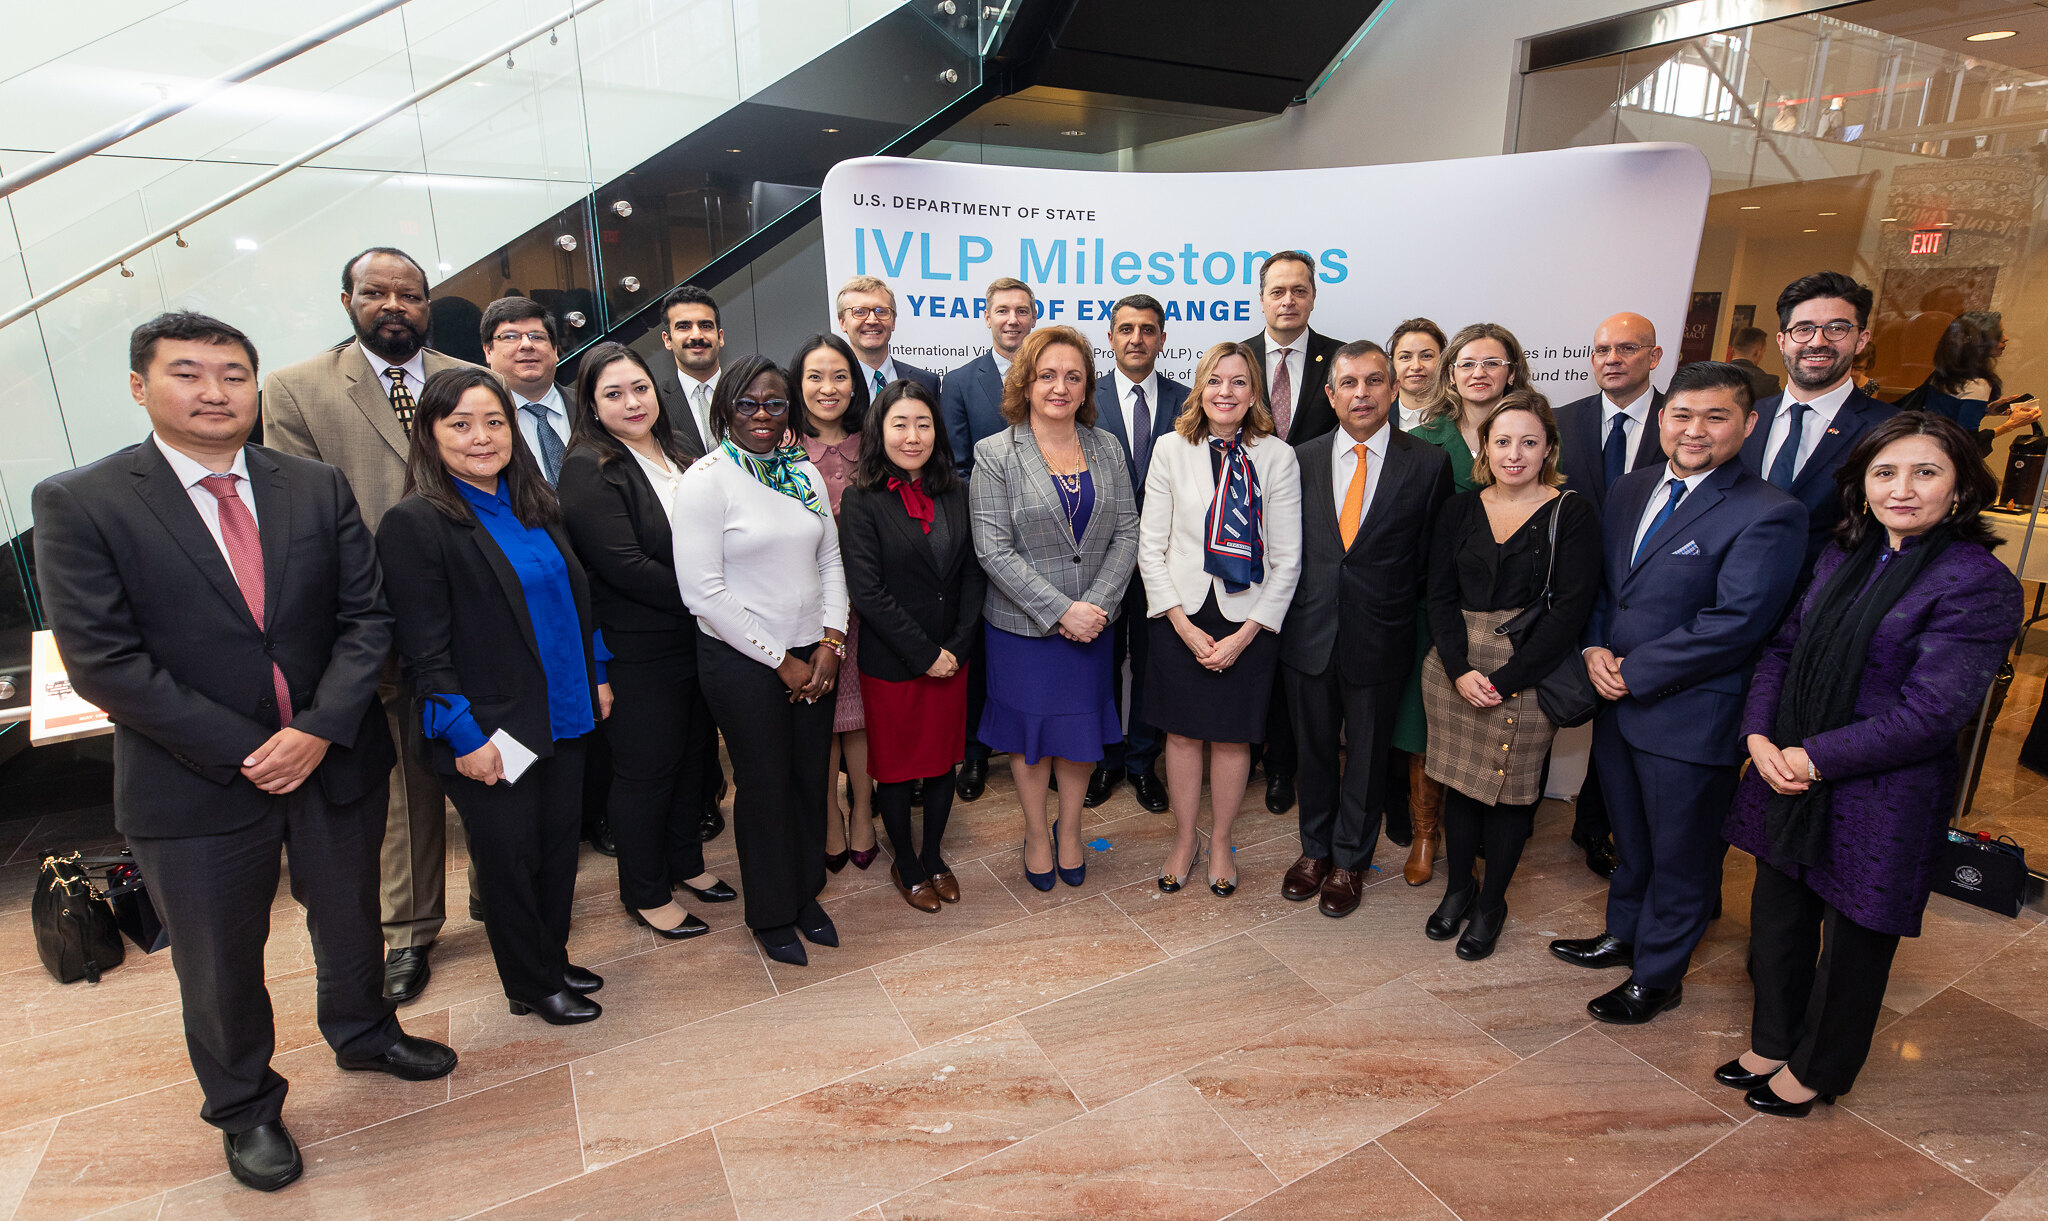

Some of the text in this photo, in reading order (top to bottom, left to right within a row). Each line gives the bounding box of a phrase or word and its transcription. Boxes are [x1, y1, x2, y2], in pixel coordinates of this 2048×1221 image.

[853, 193, 1096, 221] U.S. DEPARTMENT OF STATE
[1910, 233, 1942, 254] EXIT
[855, 228, 1349, 285] IVLP Milestons
[906, 295, 986, 318] YEAR
[1078, 299, 1251, 321] EXANGE
[888, 344, 968, 357] International
[1093, 347, 1114, 359] Pro
[1544, 346, 1557, 358] in
[1563, 346, 1593, 358] buil
[1178, 368, 1192, 379] of
[1531, 368, 1589, 381] und the
